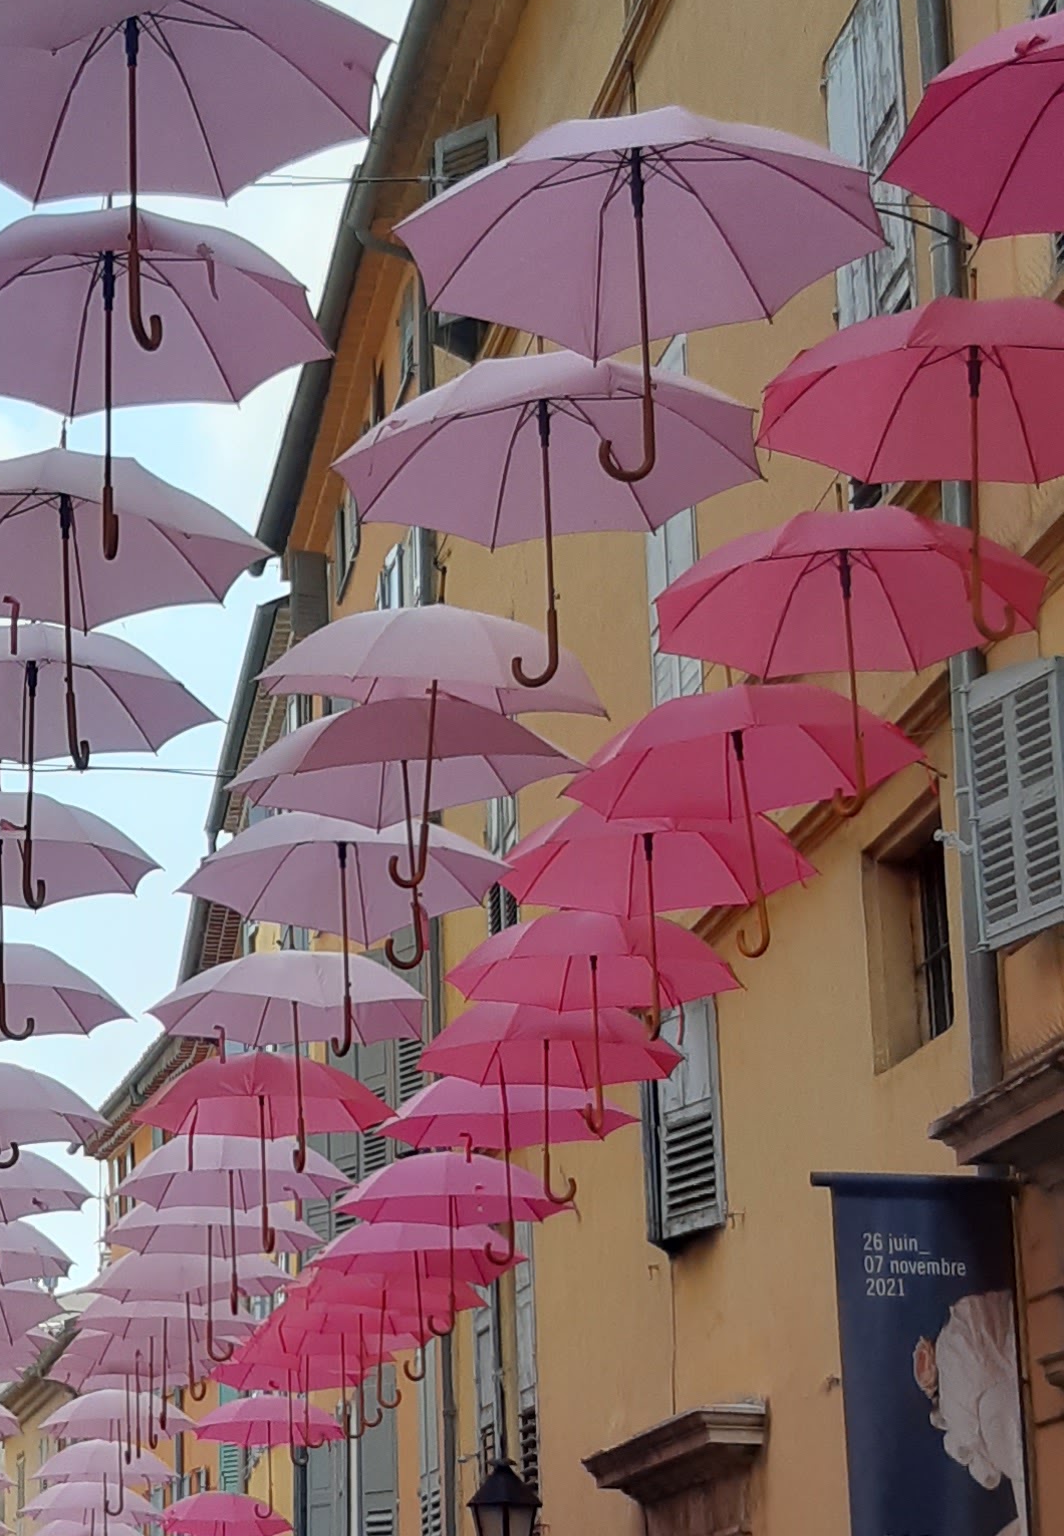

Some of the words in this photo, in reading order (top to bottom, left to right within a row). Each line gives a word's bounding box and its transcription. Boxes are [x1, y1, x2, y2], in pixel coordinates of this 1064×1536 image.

[862, 1231, 884, 1252] 26
[864, 1254, 884, 1275] 07
[890, 1256, 966, 1277] novembre
[866, 1277, 905, 1297] 2021
